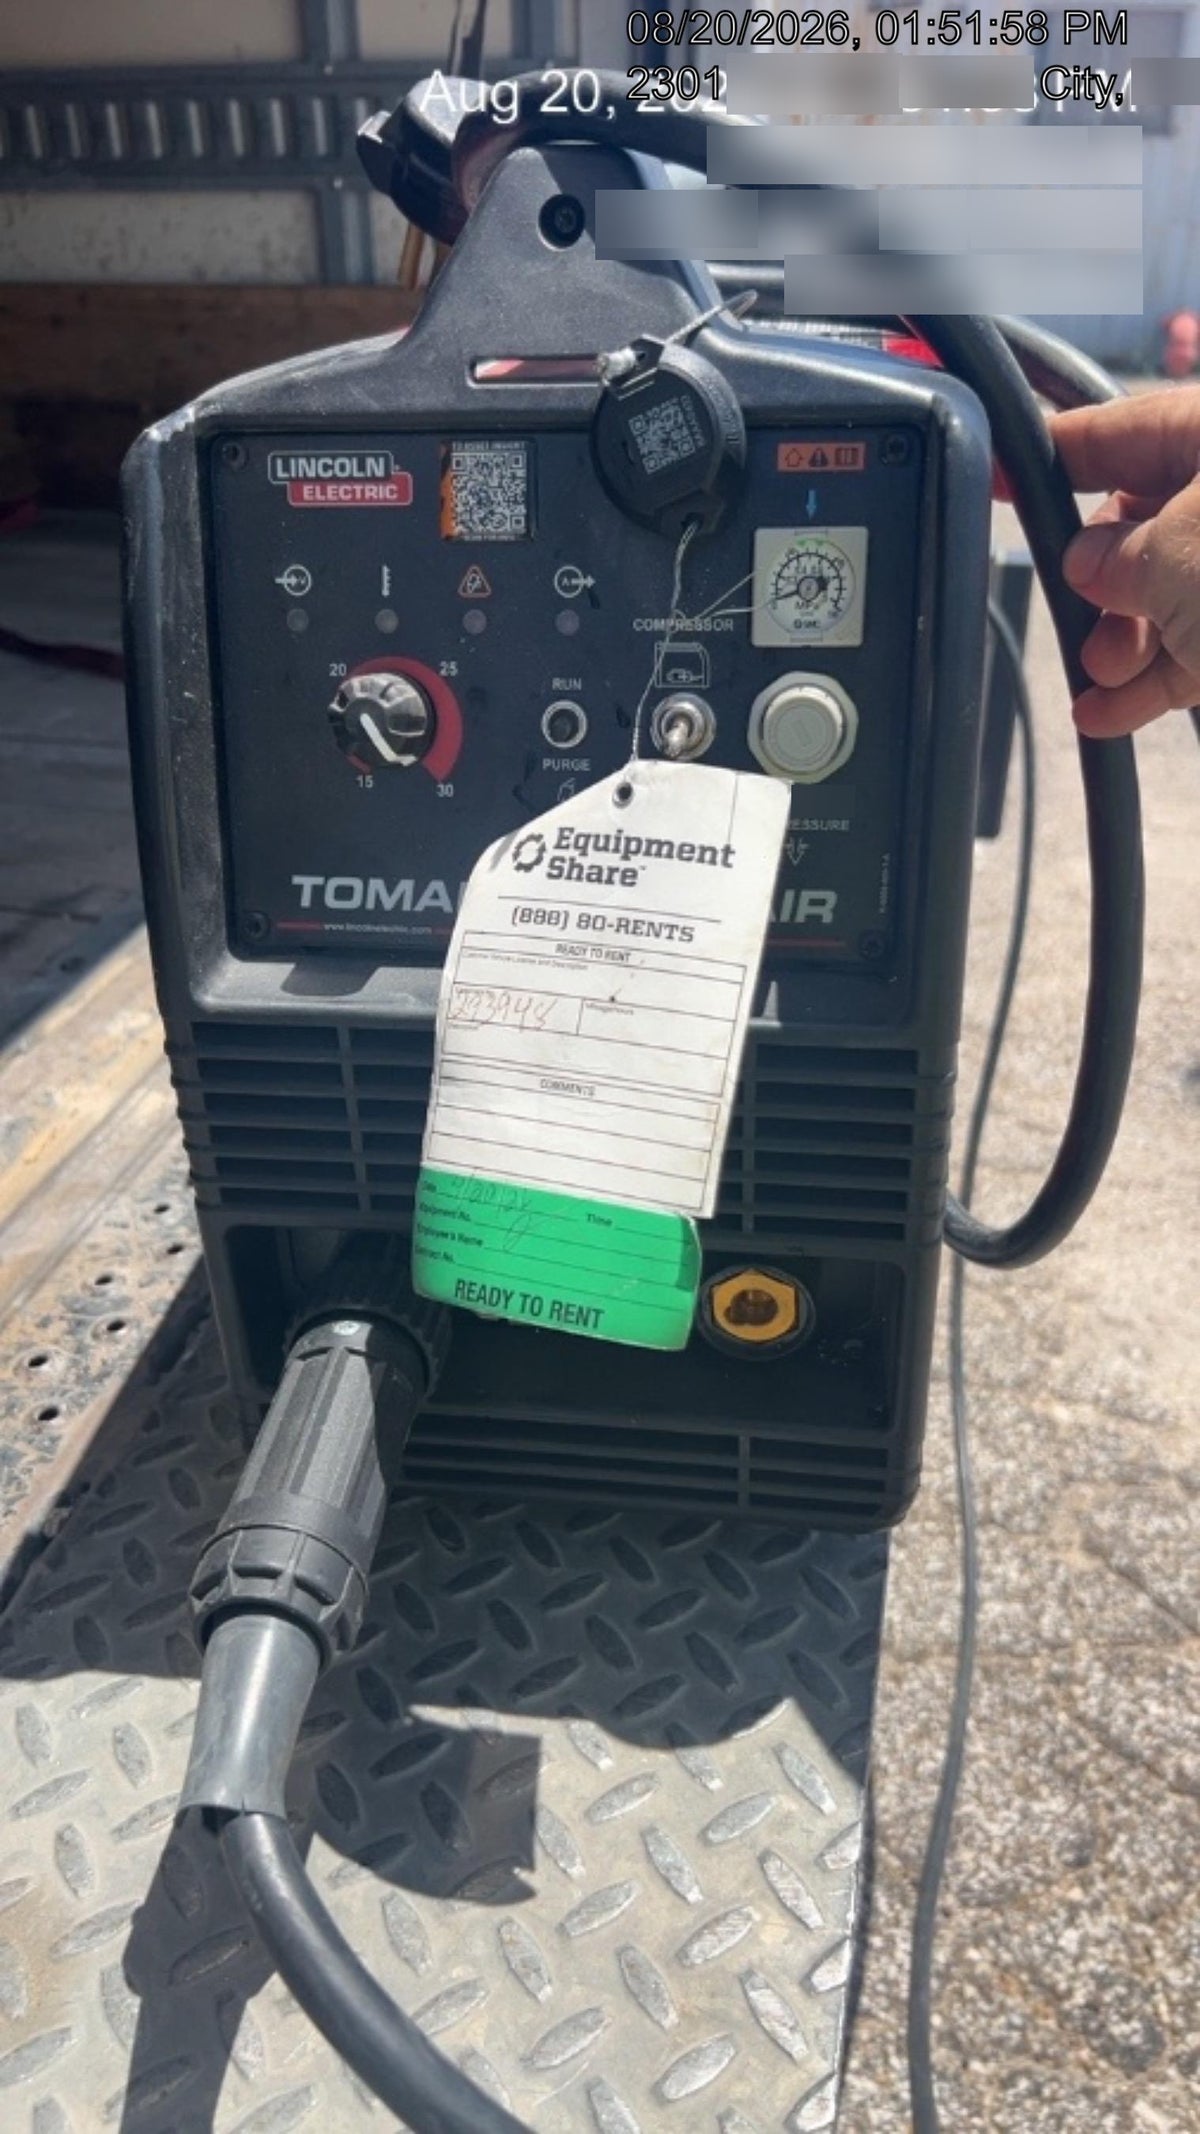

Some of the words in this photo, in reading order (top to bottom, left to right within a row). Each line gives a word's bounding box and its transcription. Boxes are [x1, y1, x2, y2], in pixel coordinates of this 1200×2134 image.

[276, 457, 386, 478] LINCOLN
[302, 484, 399, 501] ELECTRIC
[633, 617, 734, 632] COMPRESSOR
[329, 663, 348, 676] 20
[439, 661, 458, 676] 25
[552, 678, 582, 690] RUN
[542, 759, 591, 771] PURGE
[357, 775, 374, 788] 15
[436, 784, 454, 797] 30
[553, 826, 736, 869] Equipment
[546, 855, 640, 887] Share
[291, 874, 467, 914] TOMA
[769, 889, 839, 923] IR
[511, 906, 569, 931] (888)
[576, 914, 695, 943] 80-RENTS
[555, 943, 588, 958] READY
[590, 948, 603, 959] TO
[604, 949, 632, 962] RENT
[540, 1078, 596, 1097] COMMENTS
[587, 1213, 613, 1227] Time
[453, 1278, 515, 1309] READY
[519, 1291, 544, 1317] TO
[550, 1299, 606, 1330] RENT
